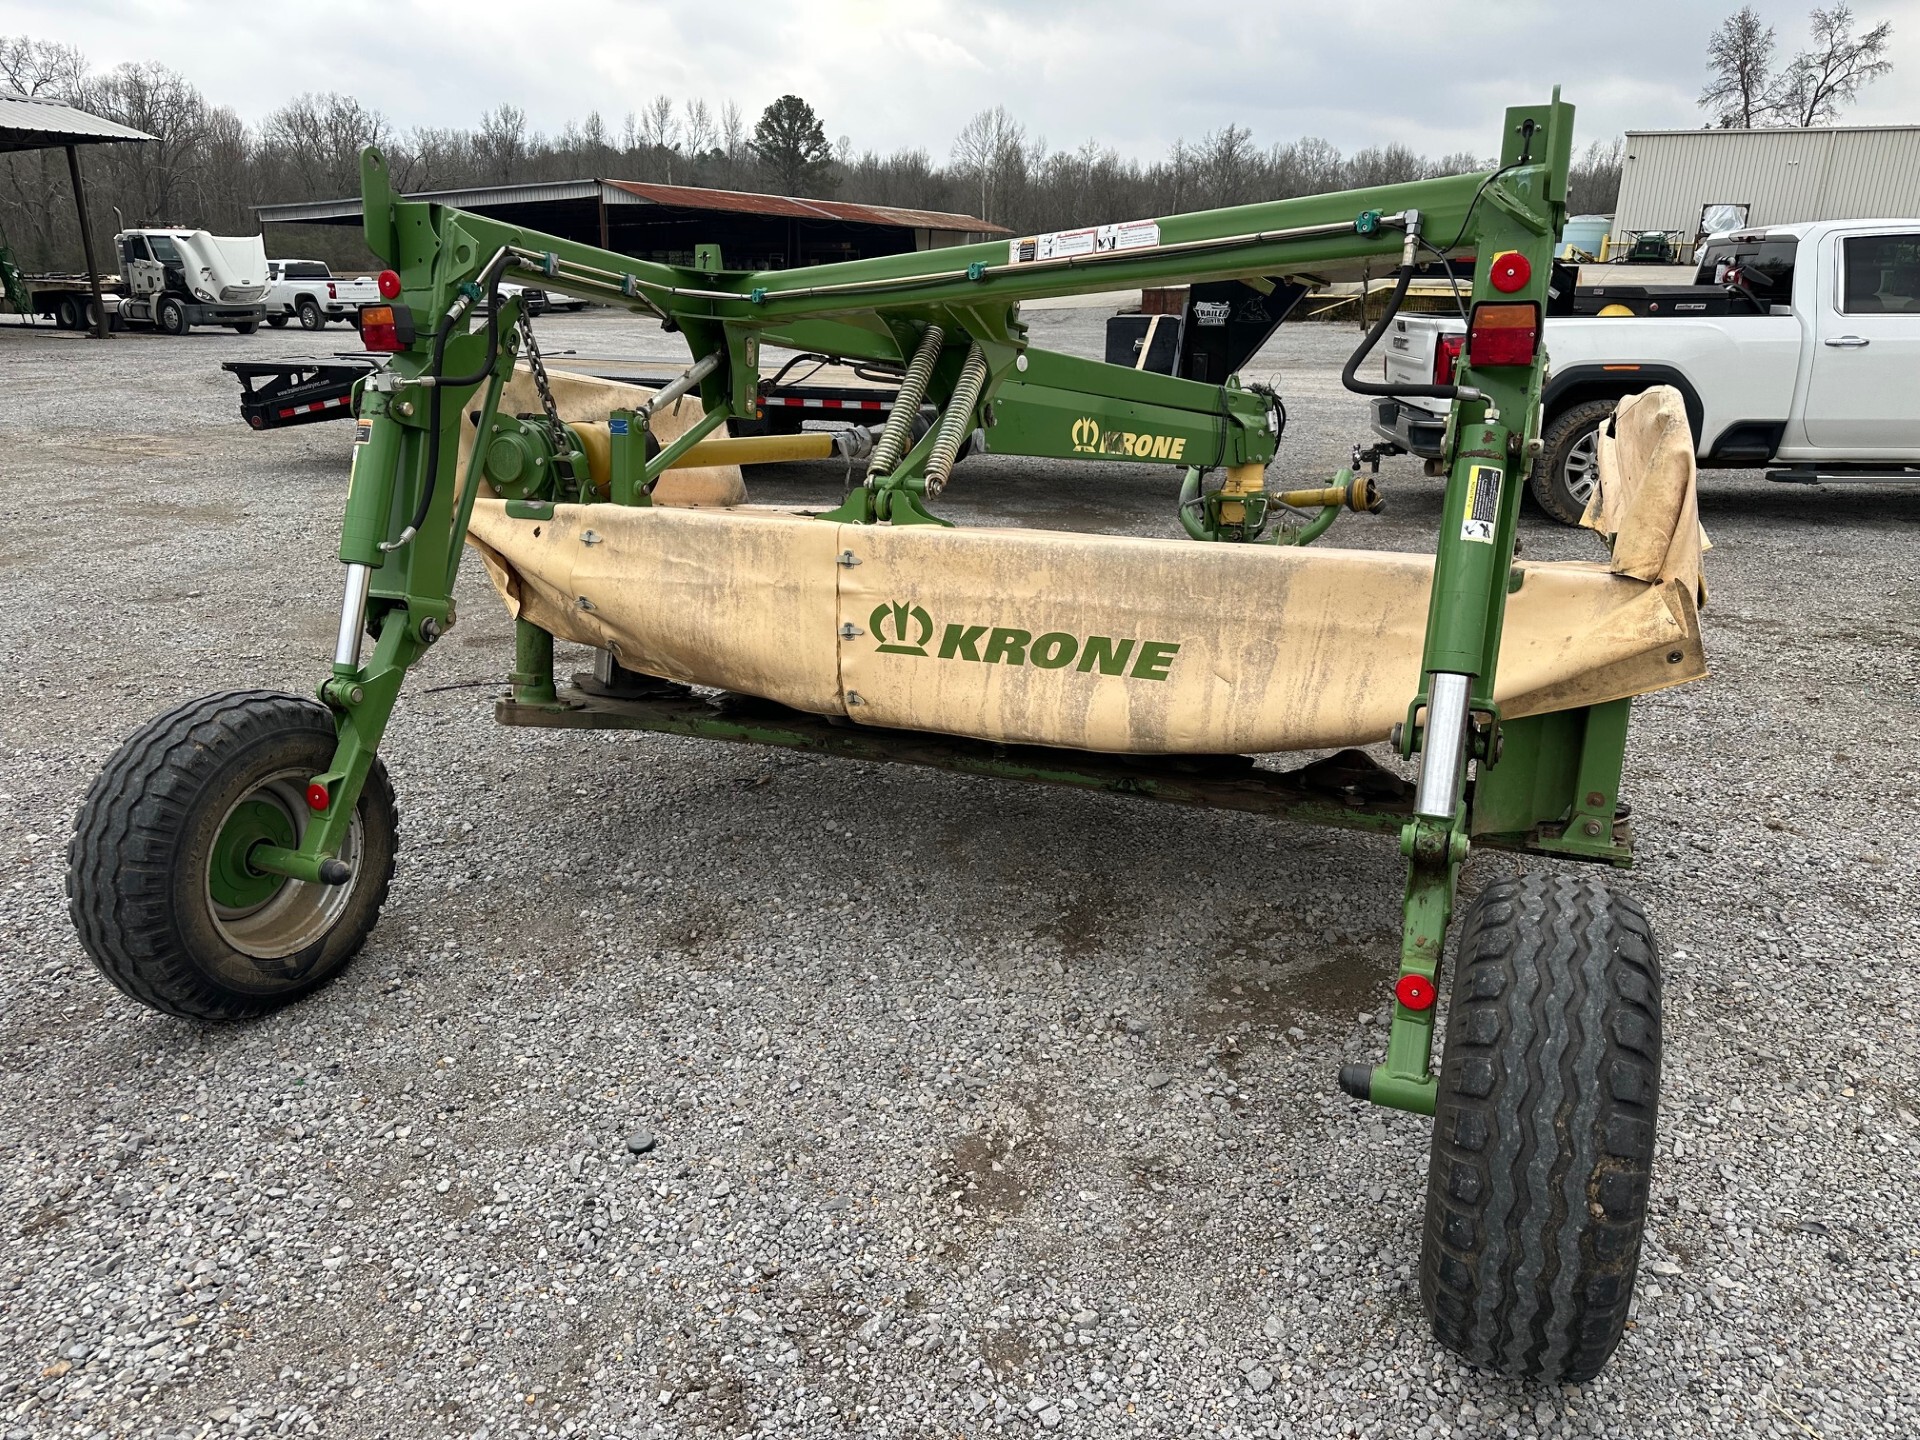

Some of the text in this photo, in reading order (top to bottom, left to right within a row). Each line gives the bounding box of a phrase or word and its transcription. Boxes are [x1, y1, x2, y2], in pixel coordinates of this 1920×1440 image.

[1193, 308, 1231, 318] TRAILER
[1099, 430, 1187, 460] KRONE
[937, 623, 1181, 682] KRONE
